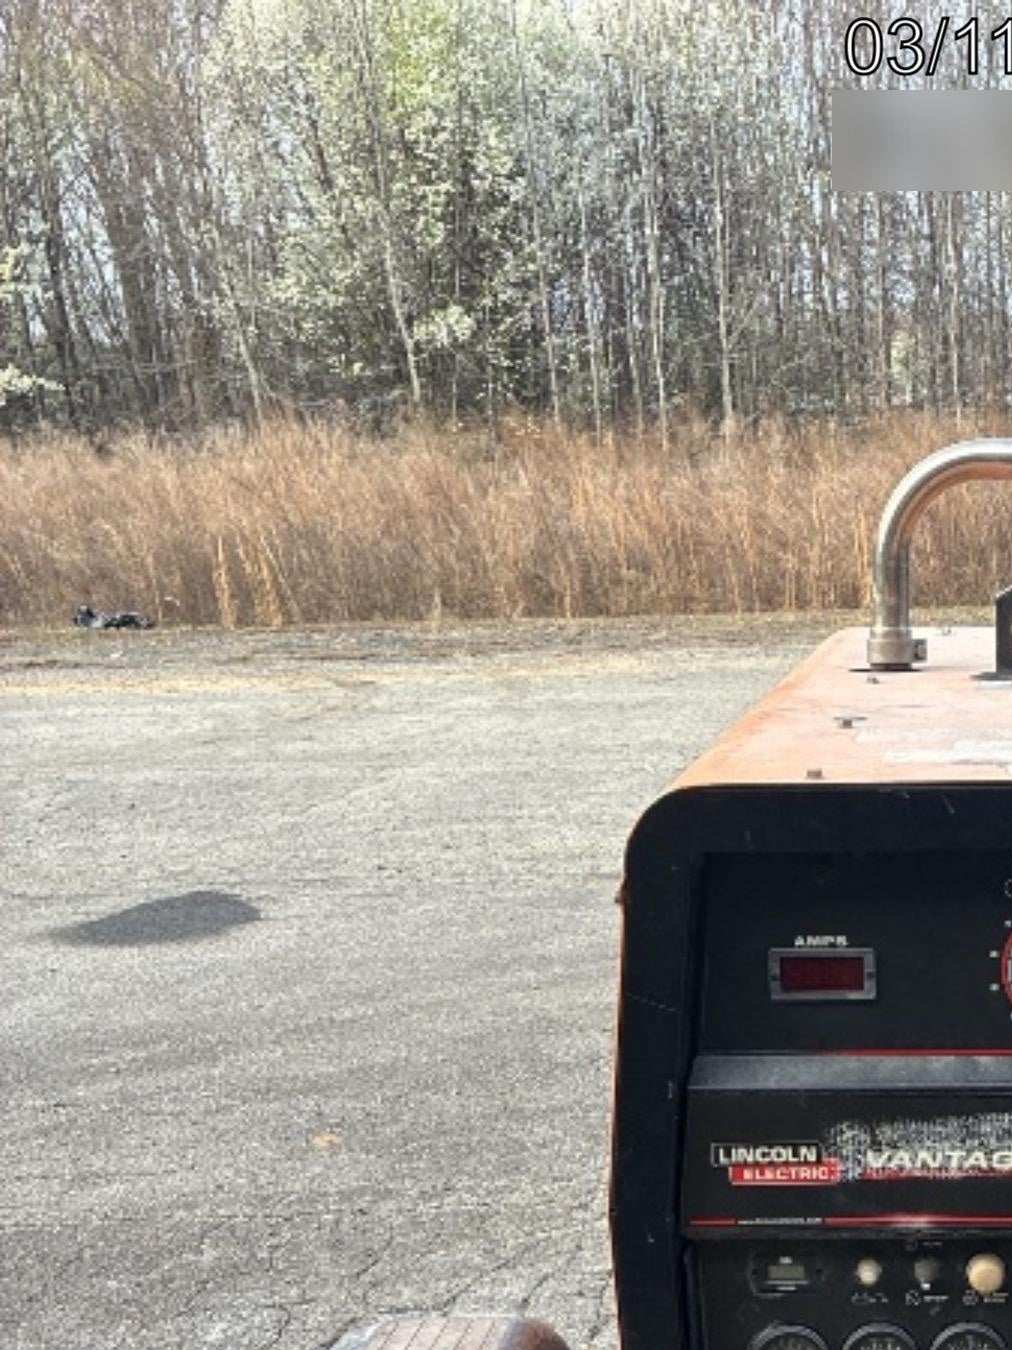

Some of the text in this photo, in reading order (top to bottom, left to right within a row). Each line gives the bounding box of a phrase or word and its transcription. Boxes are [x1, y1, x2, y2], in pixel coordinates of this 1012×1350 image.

[794, 935, 848, 947] AMPS
[718, 1146, 817, 1163] LINCOLN
[742, 1166, 828, 1180] ELECTRIC
